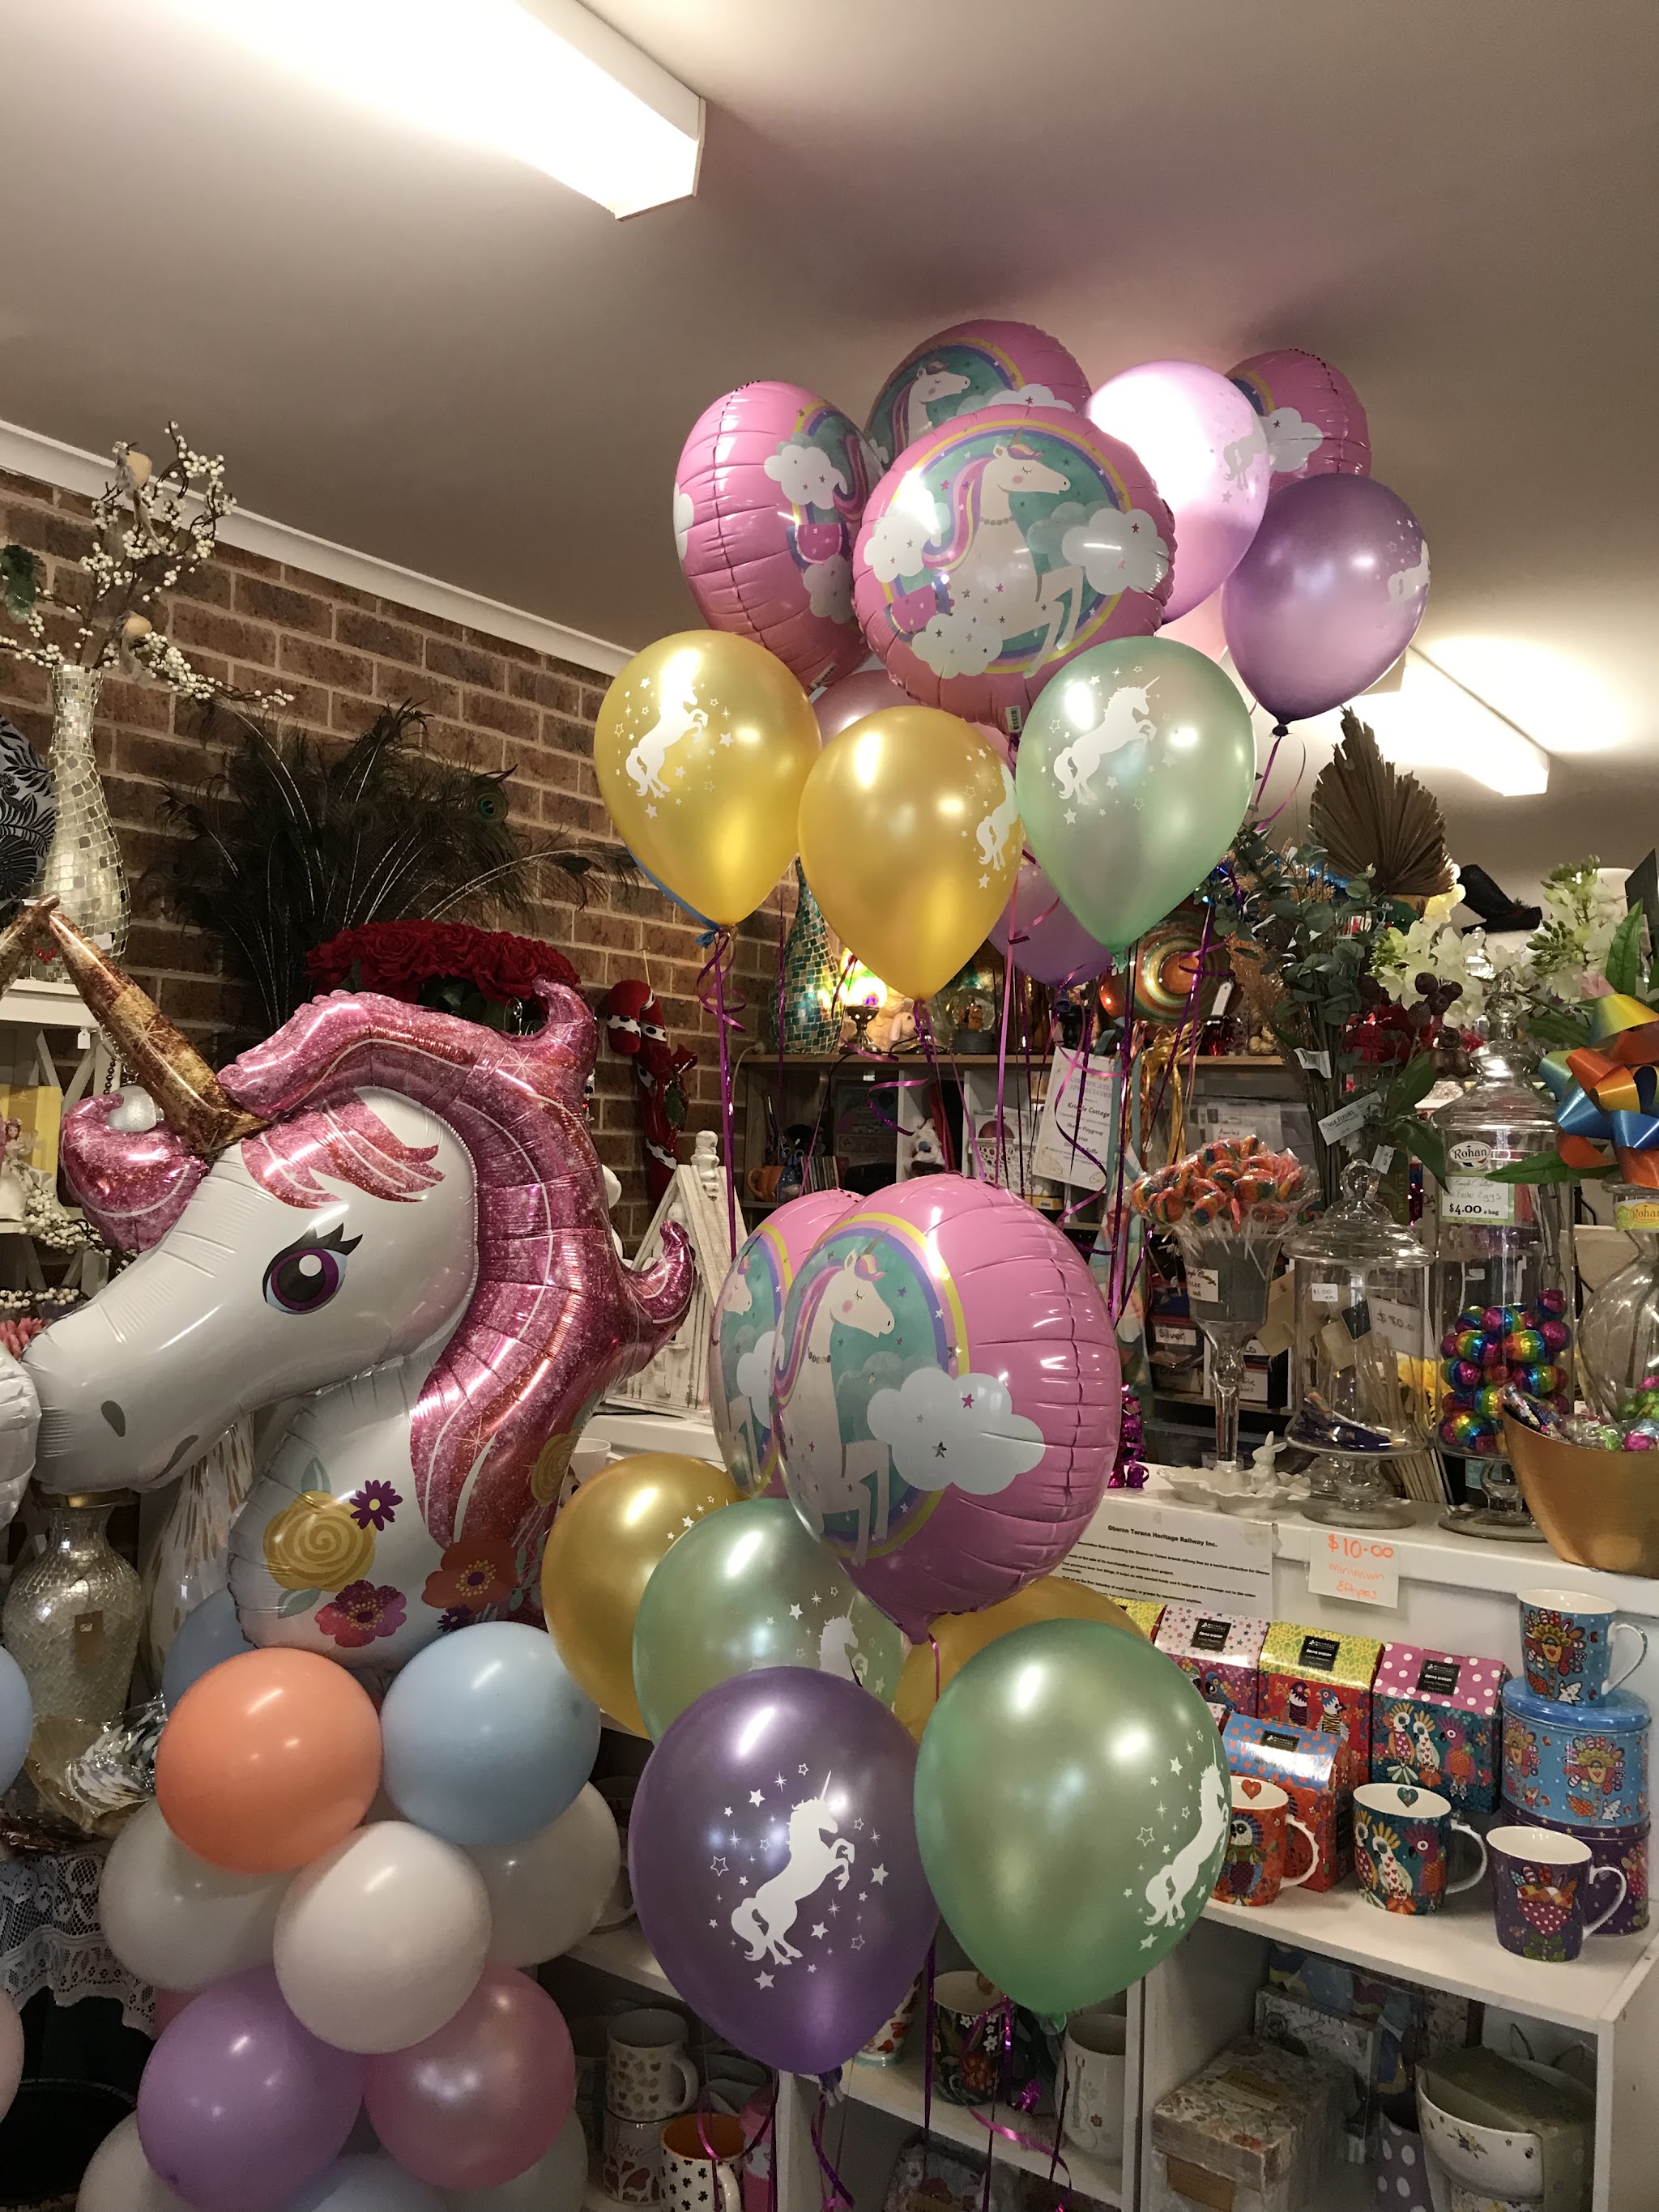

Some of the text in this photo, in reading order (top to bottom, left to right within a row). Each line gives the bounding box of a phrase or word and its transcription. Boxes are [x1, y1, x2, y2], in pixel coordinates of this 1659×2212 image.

[1454, 1149, 1486, 1160] Rohan
[1449, 1203, 1482, 1215] $4.00
[1158, 1329, 1185, 1340] Silver
[1107, 1524, 1129, 1533] Oberon
[1130, 1528, 1151, 1537] Tarana
[1152, 1532, 1179, 1542] Heritage
[1179, 1536, 1205, 1547] Railway
